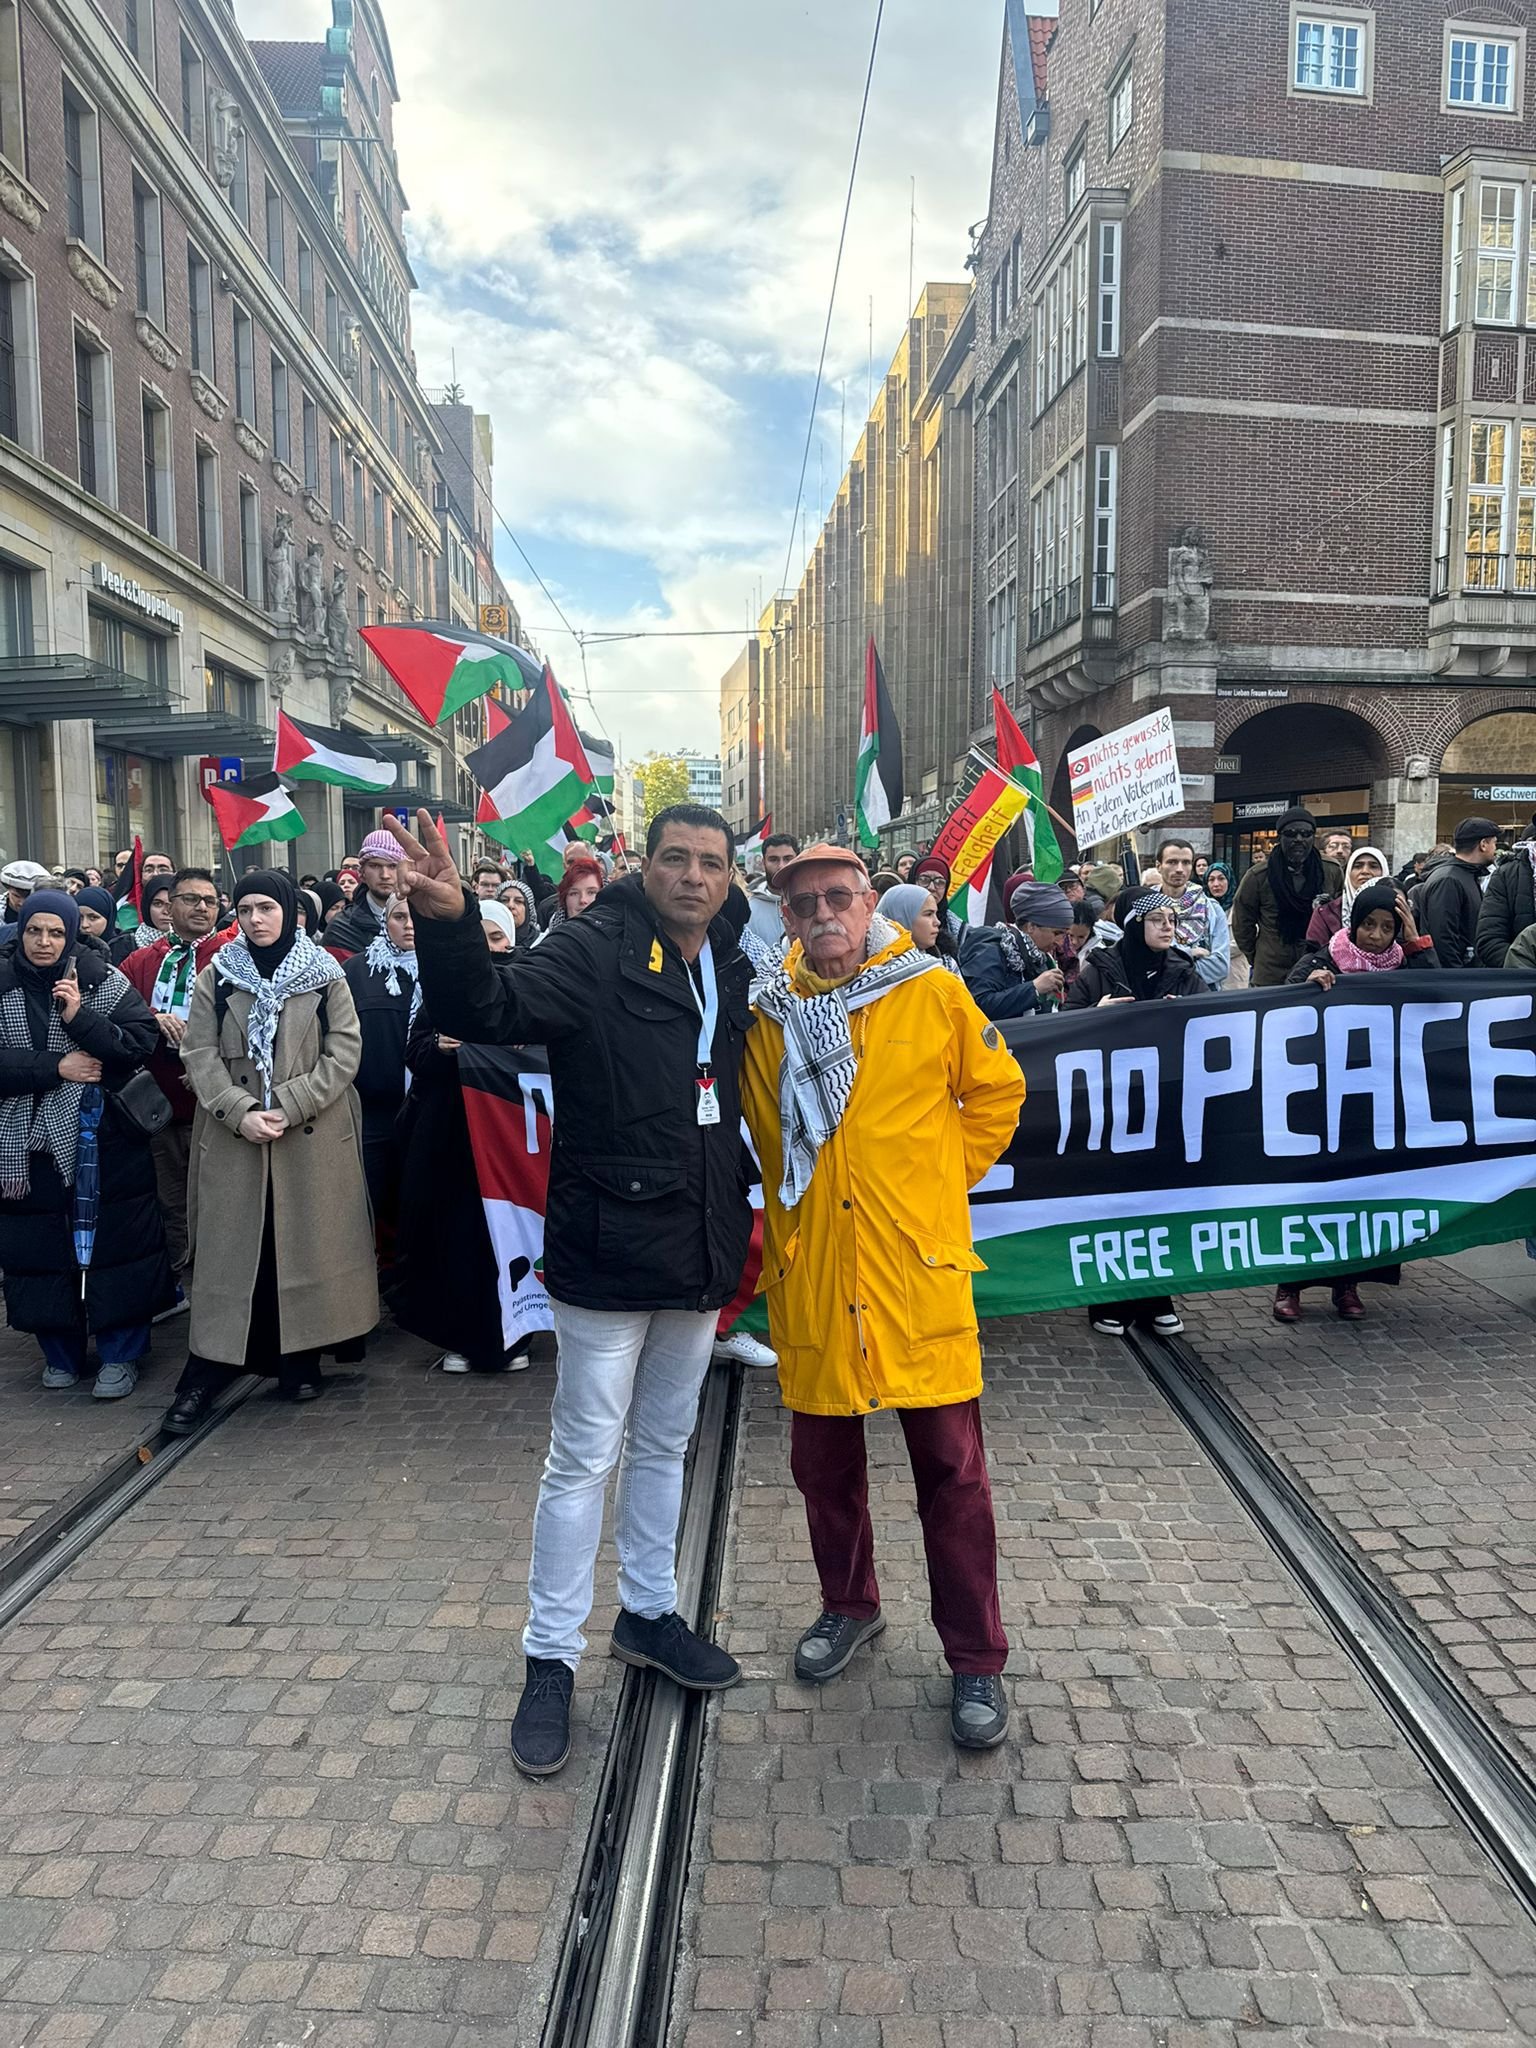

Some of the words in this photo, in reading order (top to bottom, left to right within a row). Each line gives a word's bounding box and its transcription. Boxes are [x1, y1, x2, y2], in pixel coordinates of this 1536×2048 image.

[1233, 688, 1249, 697] Lieben
[1251, 688, 1267, 697] Frauen
[1268, 688, 1288, 697] Kirchhof
[1090, 741, 1119, 769] nichts
[1093, 761, 1131, 794] nichts
[1134, 739, 1173, 778] gelernt
[1077, 826, 1098, 848] sind
[1139, 789, 1180, 820] Schuld.
[1094, 794, 1123, 823] jedem
[1123, 765, 1177, 803] Völkermord
[1472, 787, 1490, 799] Tee
[952, 806, 1011, 879] Feigheit
[1181, 995, 1536, 1162] PEACE
[1069, 1226, 1174, 1286] FREE
[1191, 1209, 1440, 1273] PALESTINE!
